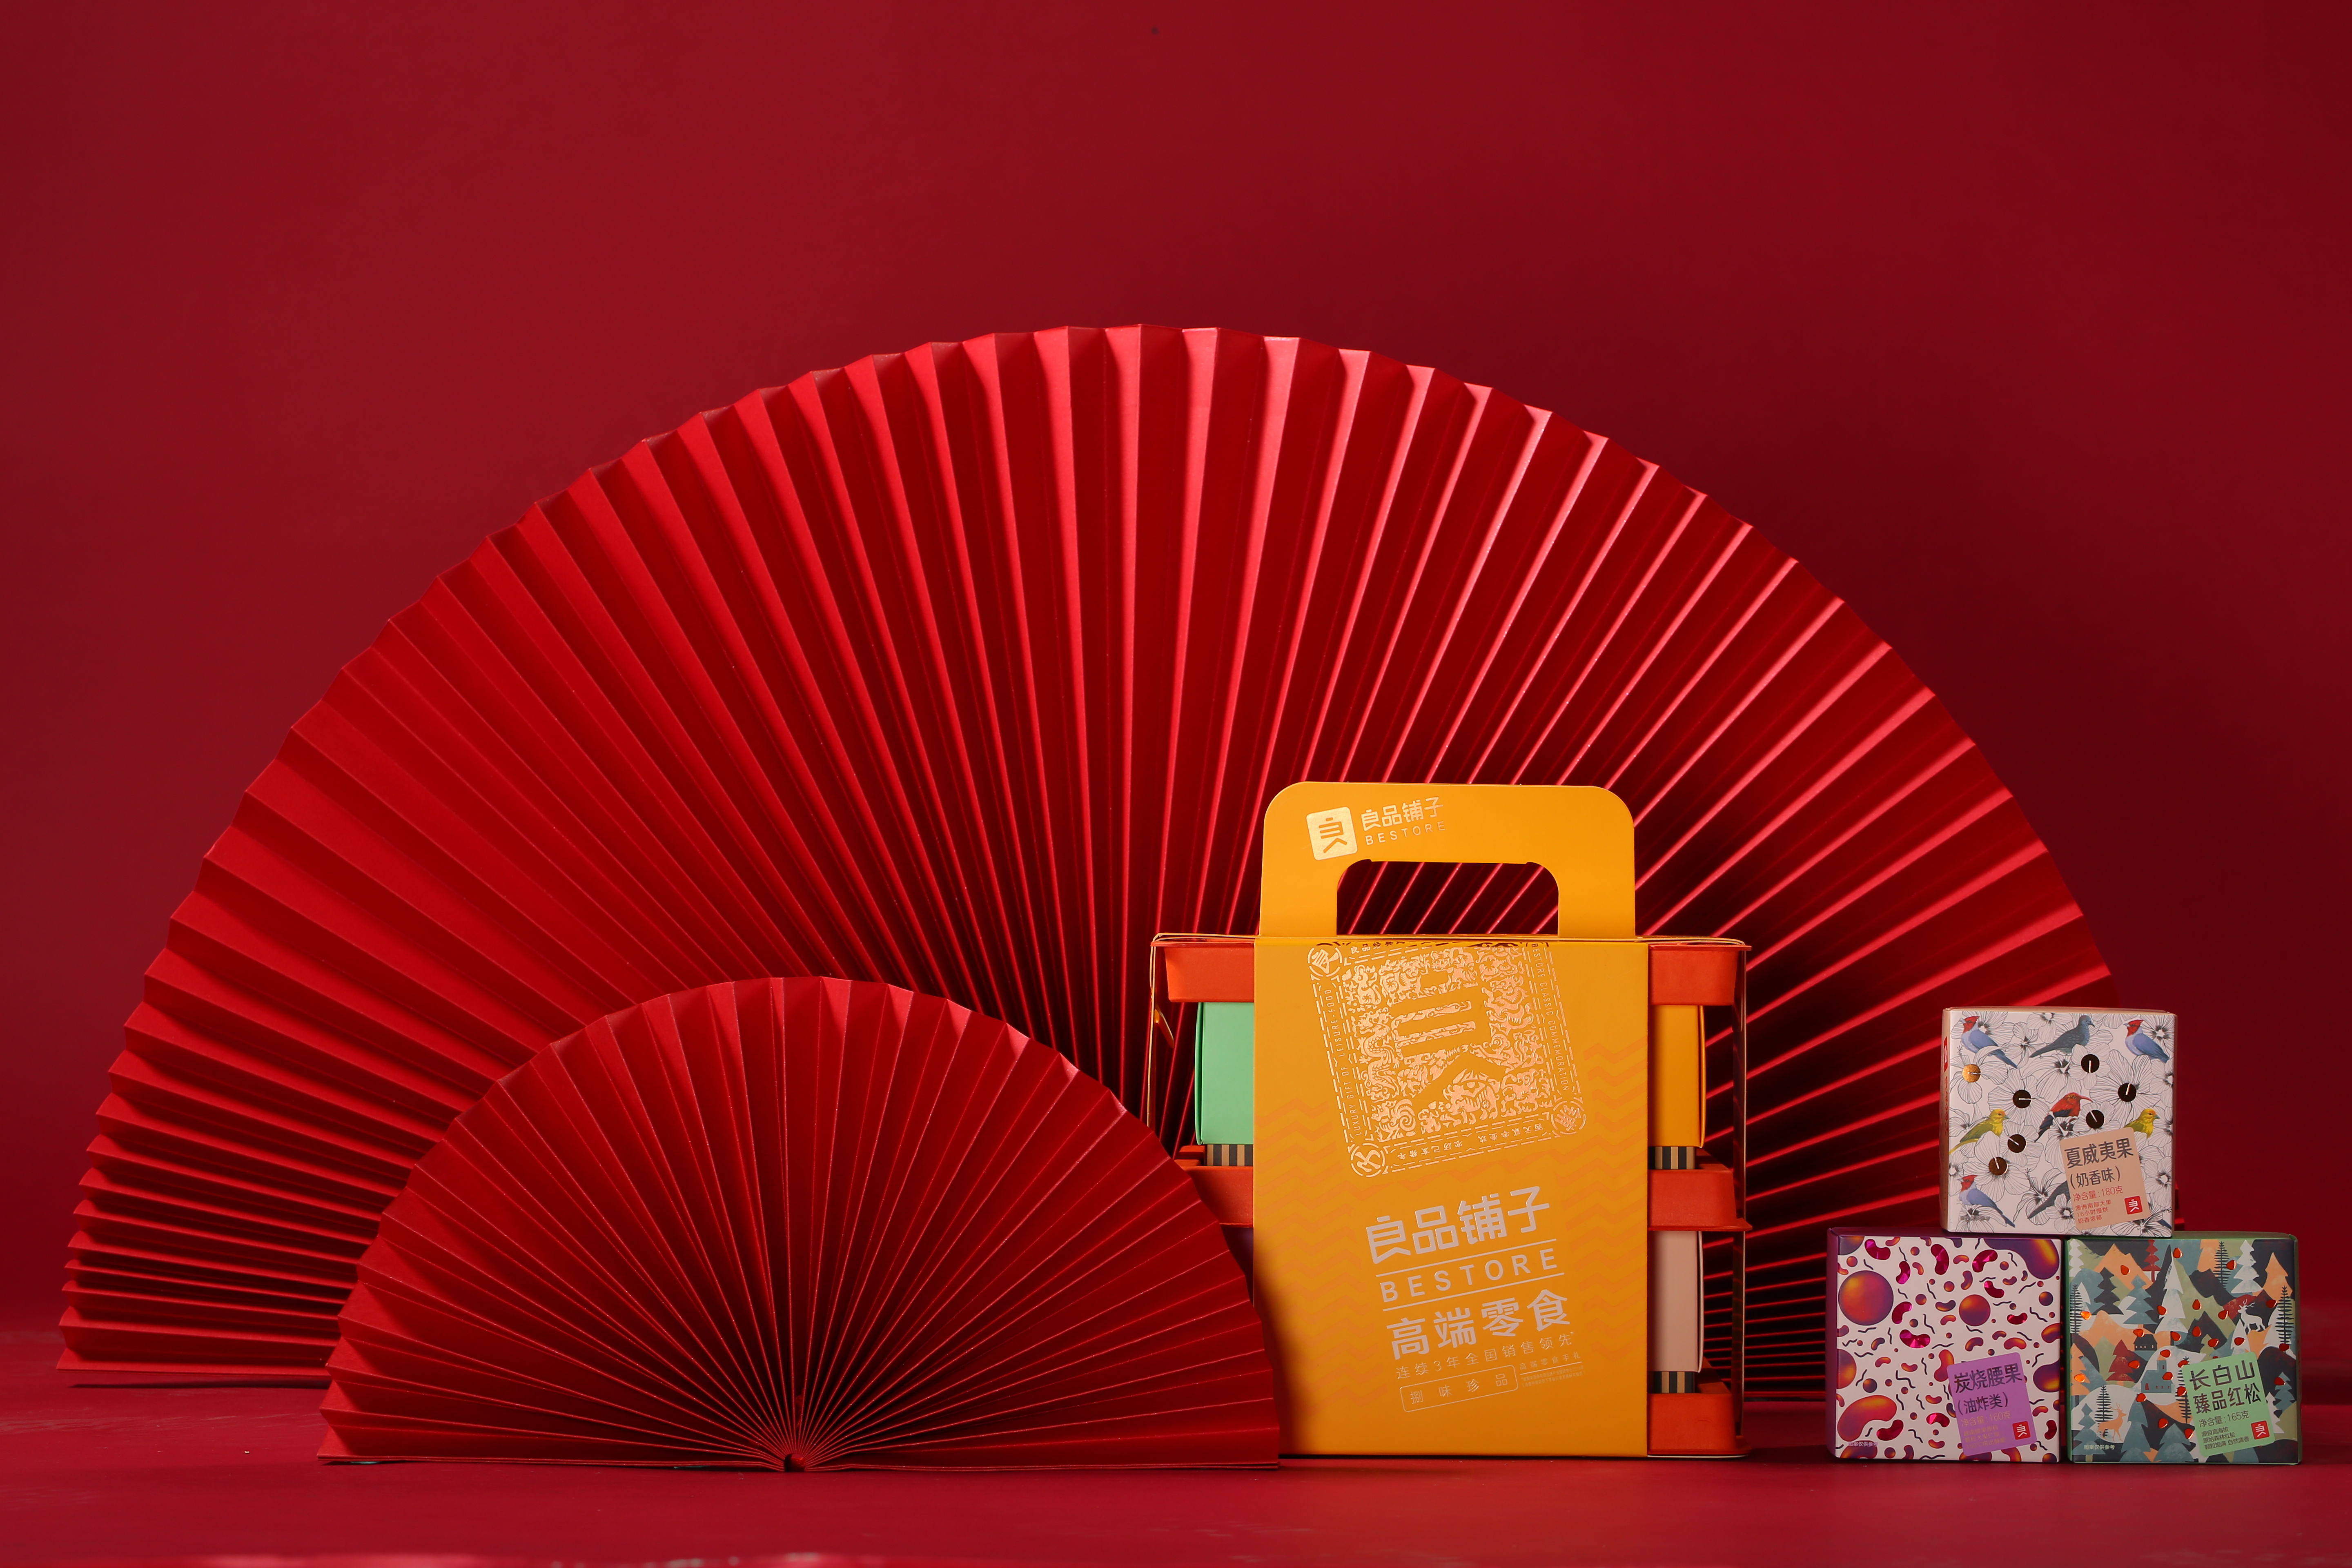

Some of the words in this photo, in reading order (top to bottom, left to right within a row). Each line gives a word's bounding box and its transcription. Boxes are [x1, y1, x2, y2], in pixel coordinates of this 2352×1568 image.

[1361, 797, 1443, 831] 良品铺子
[1365, 821, 1446, 845] BESTORE
[1325, 989, 1345, 1057] LEISURE-FOOD
[1531, 943, 1545, 978] BESTORE
[1541, 983, 1553, 1016] CLASSIC
[1548, 1022, 1568, 1091] COMMEMORATION
[1342, 1067, 1348, 1076] OF
[1349, 1105, 1361, 1136] LUXURY
[2064, 1138, 2134, 1169] 夏威夷果
[2070, 1166, 2120, 1189] （奶香味）
[2075, 1200, 2111, 1211] 澳洲南部大果
[2077, 1207, 2108, 1217] 16小时慢烘
[2078, 1215, 2102, 1224] 奶香浓郁
[1366, 1186, 1550, 1264] 良品铺子
[1380, 1248, 1557, 1303] BESTORE
[1386, 1289, 1570, 1360] 高端零食
[1519, 1352, 1581, 1370] 高端零食手礼
[2189, 1360, 2255, 1391] 长白山
[1410, 1373, 1508, 1404] 捌味珍品
[1954, 1363, 2022, 1393] 炭烧腰果
[2193, 1383, 2261, 1414] 臻品红松
